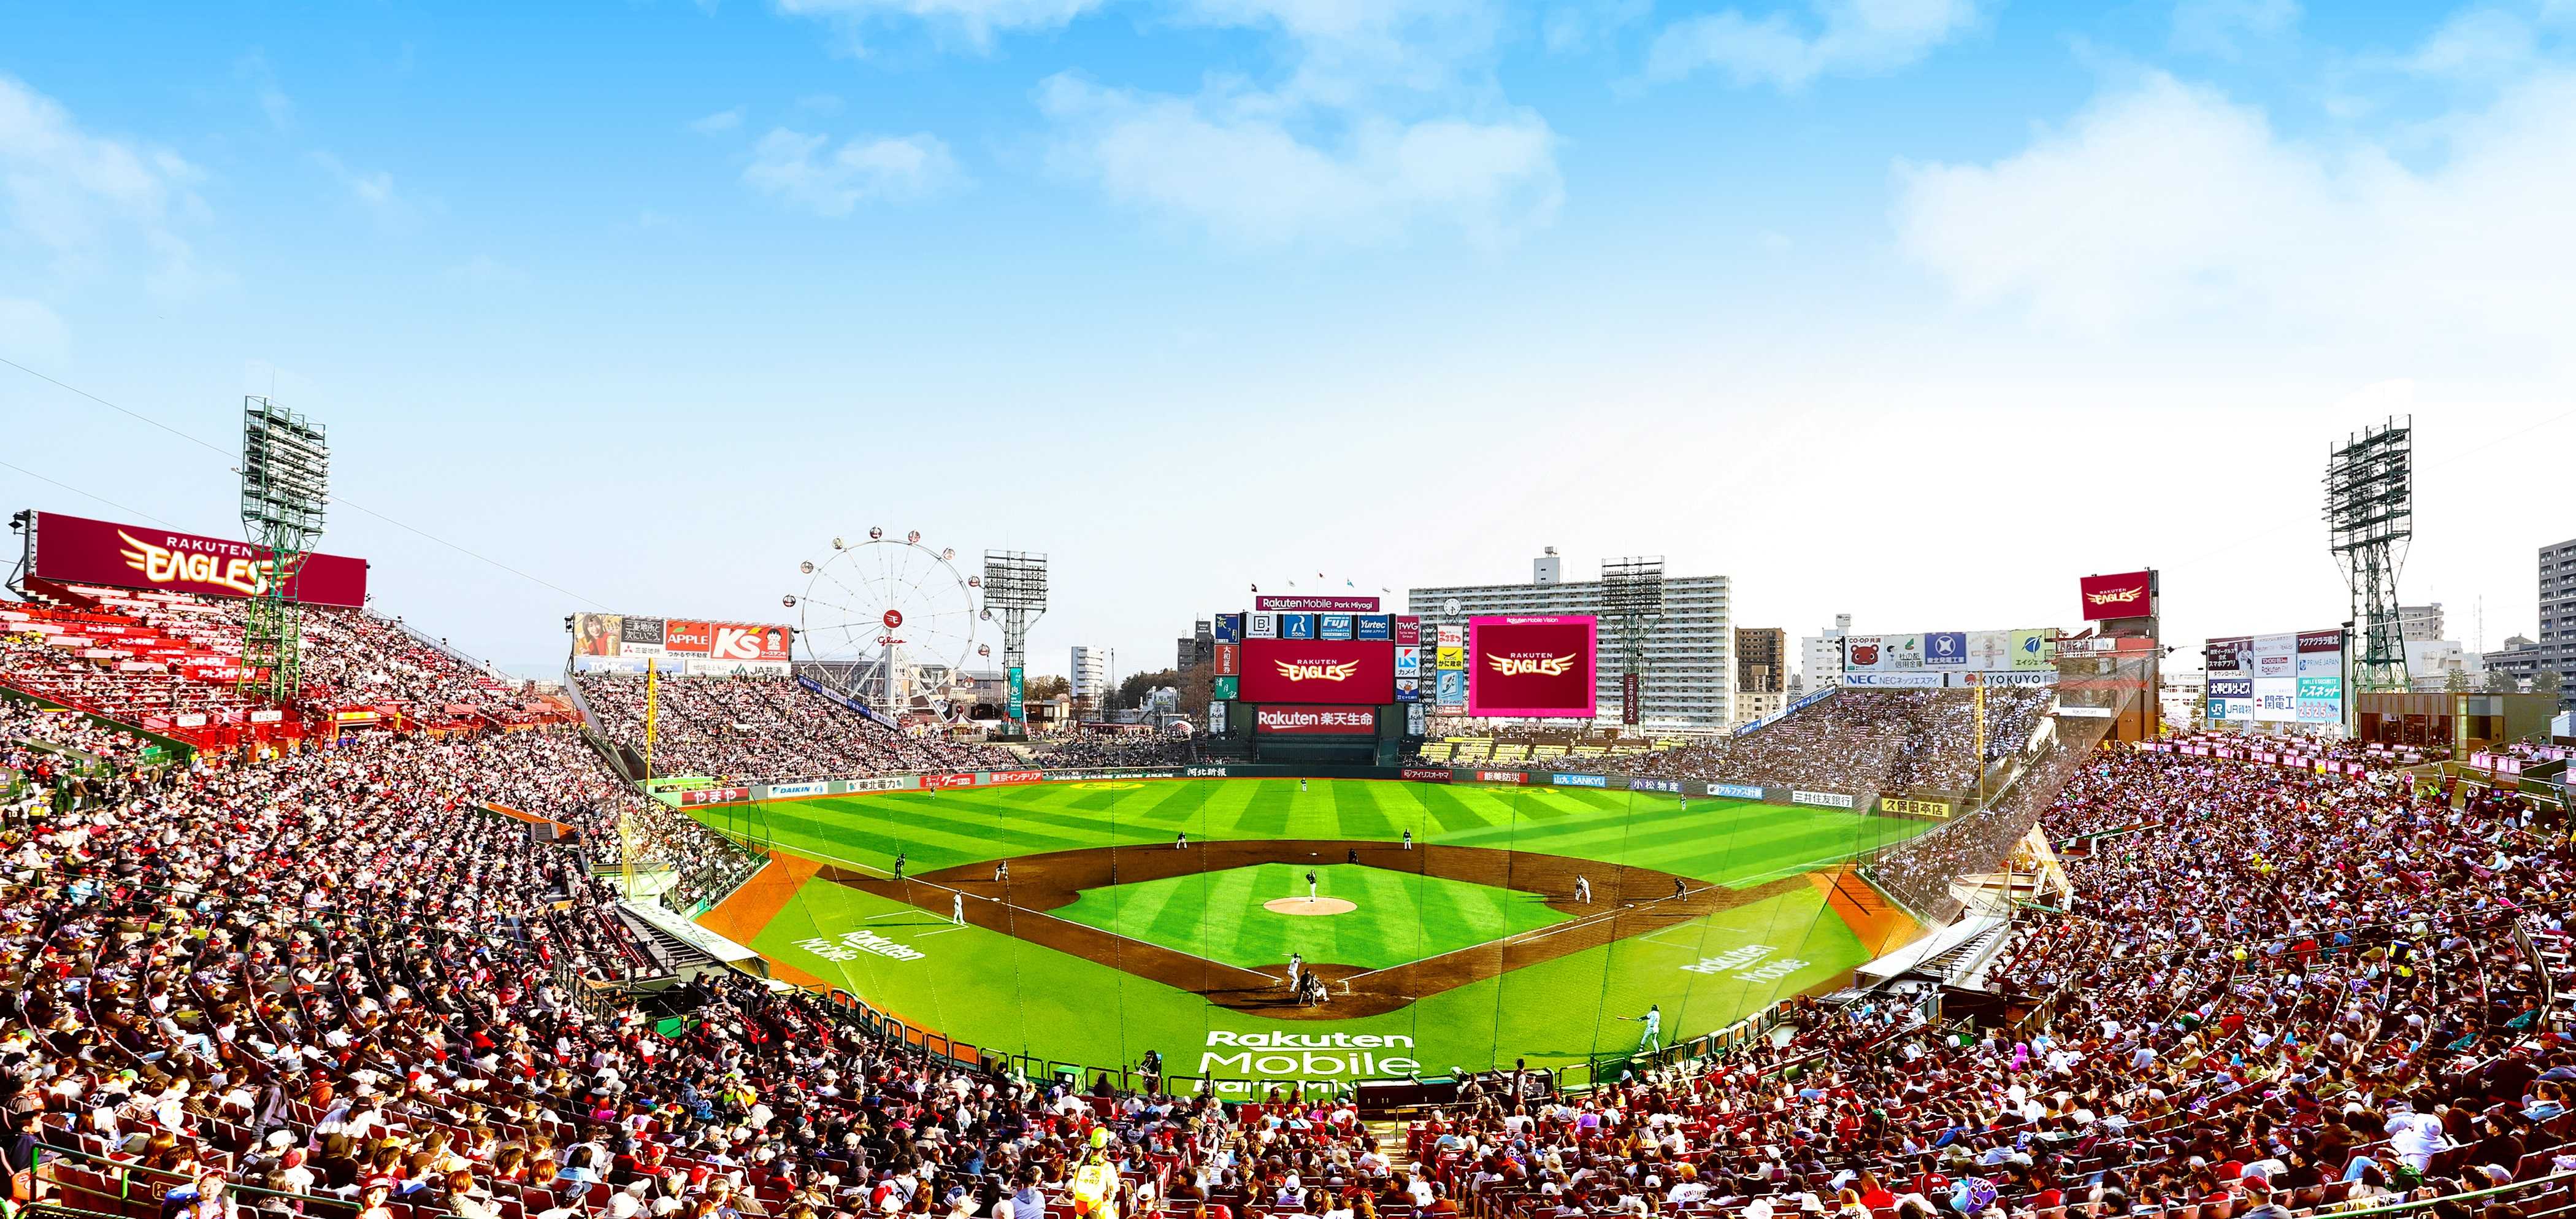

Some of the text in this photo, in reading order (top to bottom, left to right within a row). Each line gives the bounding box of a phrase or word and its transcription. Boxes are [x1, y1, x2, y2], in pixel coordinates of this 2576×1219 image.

[166, 536, 253, 557] RAKUTEN
[138, 541, 279, 594] EAGLES
[1263, 598, 1301, 609] Rakuten
[1303, 599, 1332, 608] Mobile
[2093, 590, 2136, 605] EAGLES
[626, 621, 661, 633] 三菱地所と
[1323, 617, 1349, 628] Fuji
[1361, 620, 1386, 629] Yurtec
[667, 634, 708, 645] APPLE
[878, 636, 907, 647] Glico
[2299, 635, 2339, 647] アクアクララ東北
[1286, 663, 1350, 682] EAGLES
[1498, 657, 1566, 676] EAGLES
[1847, 675, 1877, 684] NEC
[1982, 675, 2041, 684] KYOKUYO
[2210, 682, 2250, 694] 太平ビルサービス
[2299, 686, 2340, 697] トスネット
[2264, 695, 2294, 709] 関電工
[2211, 704, 2223, 713] JR
[2226, 705, 2252, 713] JR貨物
[2299, 706, 2326, 717] 2525
[1259, 710, 1373, 727] Rakuten 楽天生命
[992, 773, 1041, 782] 東京インテリア
[1187, 767, 1227, 777] 河北新報
[1484, 771, 1520, 782] 能美防災
[859, 780, 896, 791] 東北電力
[1572, 776, 1605, 786] SANKYU
[1633, 779, 1679, 793] 小松物産
[780, 786, 810, 794] DAIKIN
[694, 789, 737, 804] やまや
[1794, 791, 1851, 807] 三井住友銀行
[1886, 799, 1943, 815] 久保田本店
[791, 937, 858, 962] Mobile
[838, 930, 926, 962] Rakuten
[1677, 945, 1779, 974] Rakuten
[1205, 1031, 1416, 1049] Rakuten
[1197, 1052, 1422, 1076] Mobile
